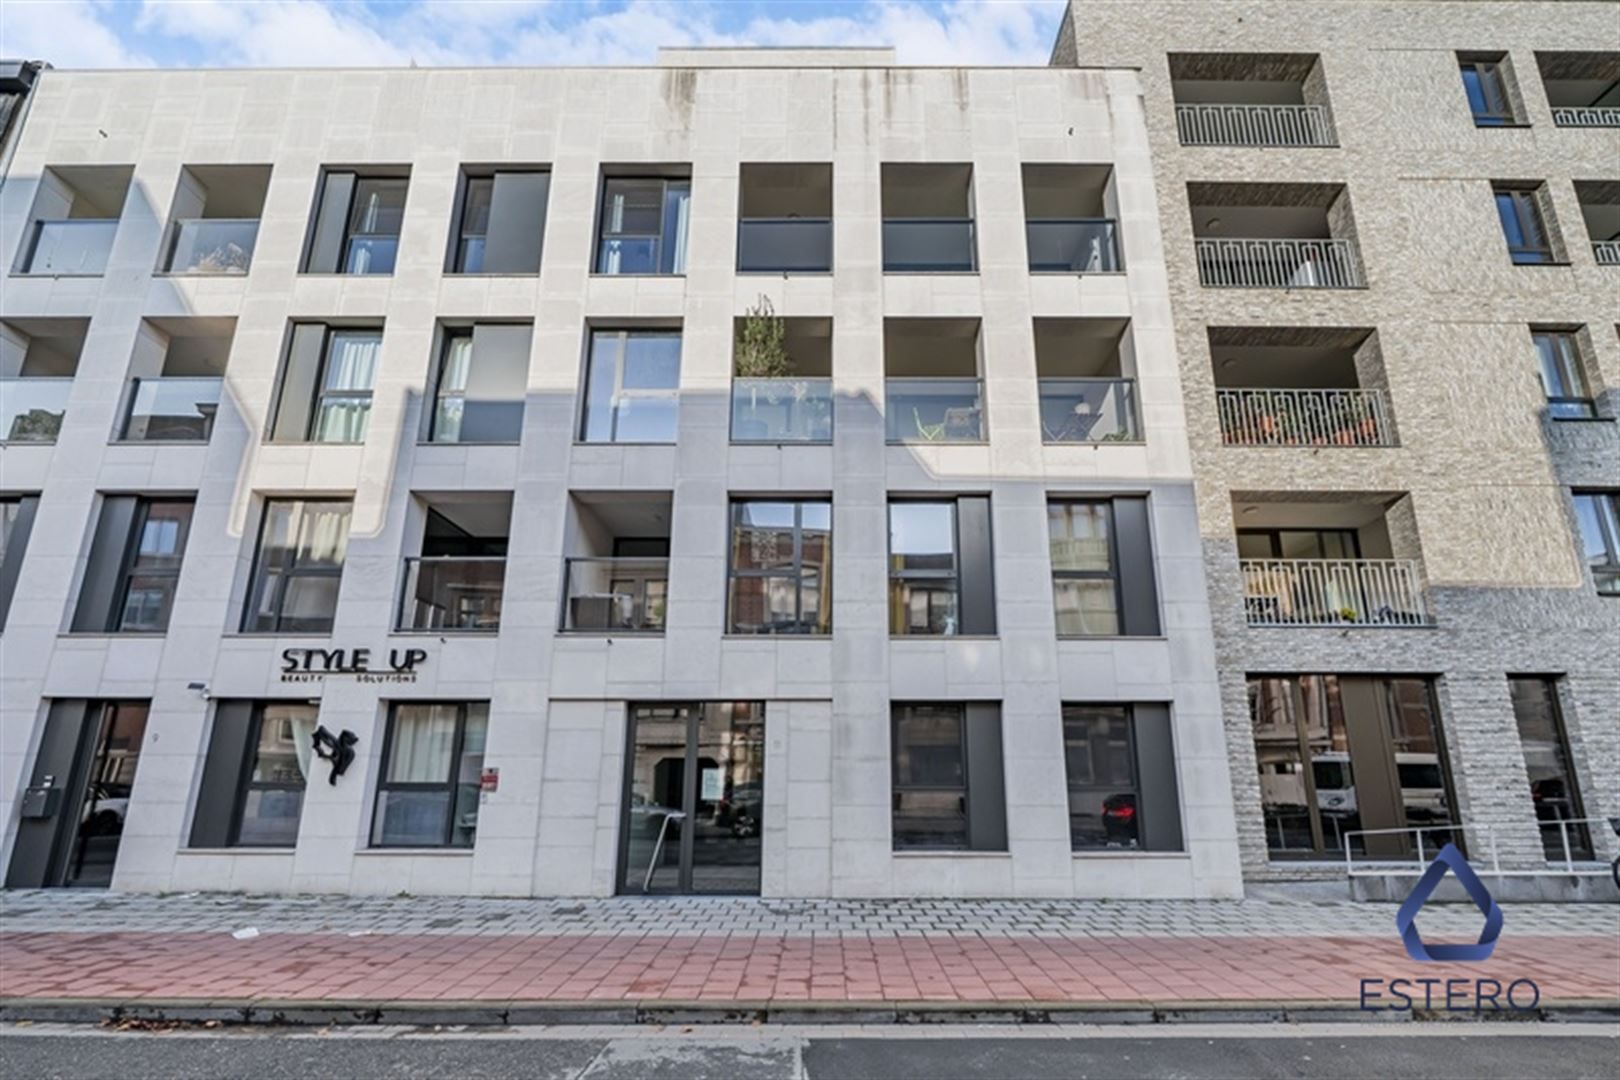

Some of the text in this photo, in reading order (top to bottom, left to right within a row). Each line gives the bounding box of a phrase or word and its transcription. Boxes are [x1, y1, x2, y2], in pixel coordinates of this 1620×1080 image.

[281, 648, 428, 673] STYLE UP
[281, 674, 417, 683] BEAUTY SOLUTIONS
